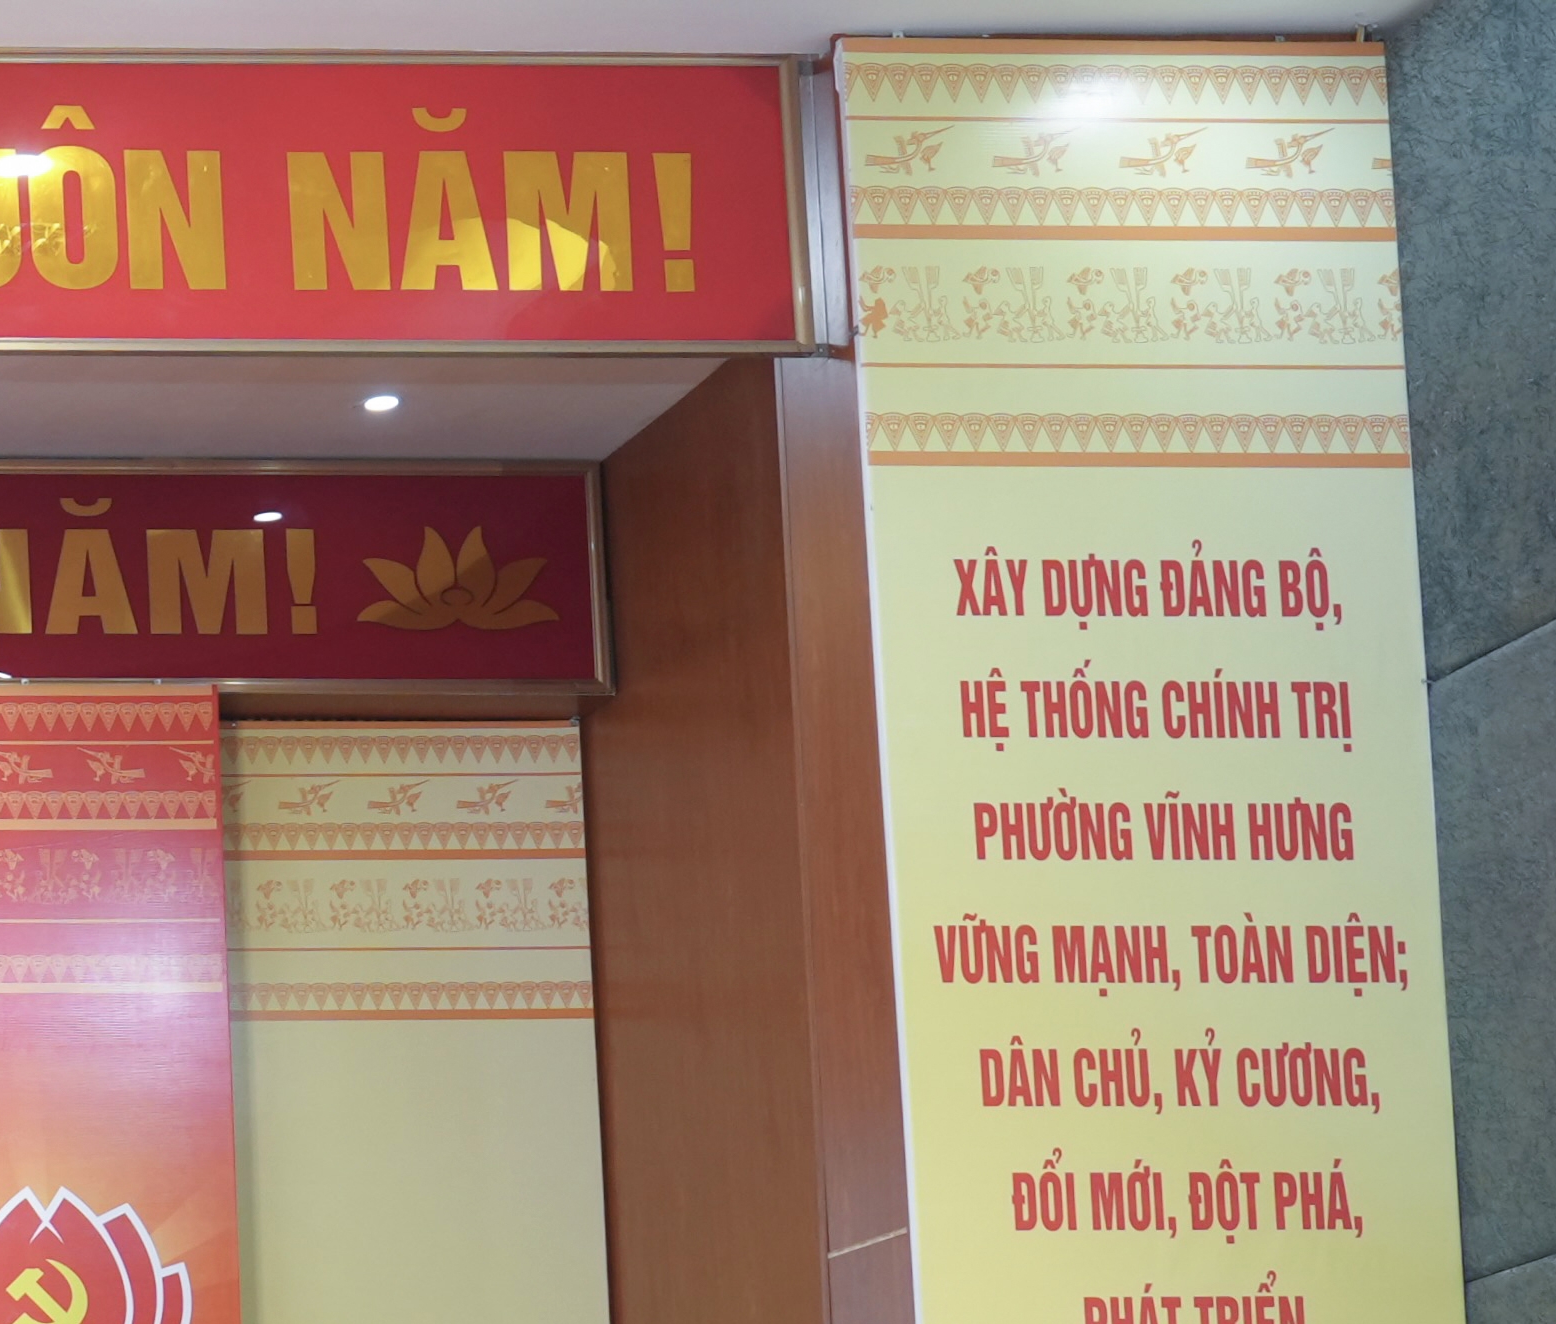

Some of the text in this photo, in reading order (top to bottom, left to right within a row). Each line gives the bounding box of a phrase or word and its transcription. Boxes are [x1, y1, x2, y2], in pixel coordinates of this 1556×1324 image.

[283, 105, 699, 295] NĂM!
[954, 539, 1343, 631] XÂY DỰNG ĐẢNG BỘ,
[959, 659, 1353, 753] HỆ THỐNG CHÍNH TRỊ
[973, 787, 1355, 862] PHƯỜNG VĨNH HƯNG
[933, 912, 1409, 998] VỮNG MẠNH, TOÀN DIỆN;
[978, 1027, 1382, 1114] DÂN CHỦ, KỶ CƯƠNG,
[1011, 1147, 1365, 1245] ĐỔI MỚI, ĐỘT PHÁ,
